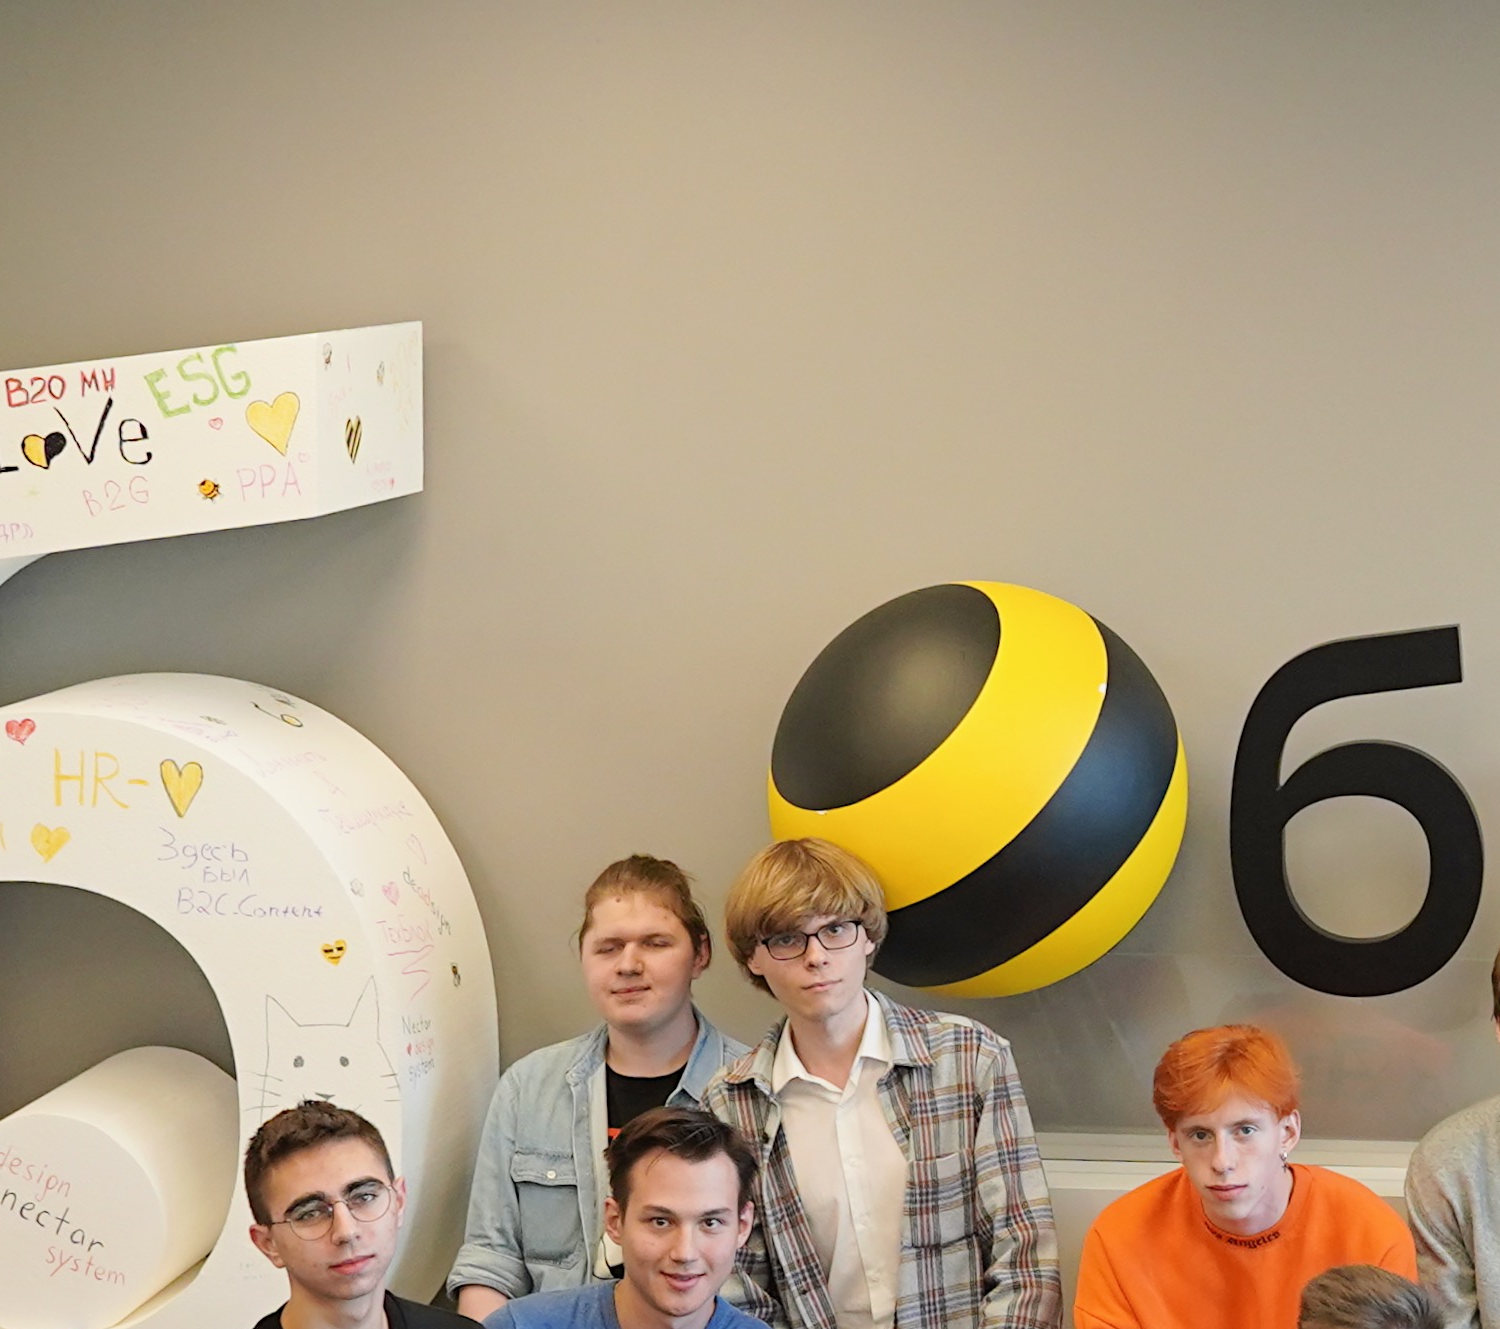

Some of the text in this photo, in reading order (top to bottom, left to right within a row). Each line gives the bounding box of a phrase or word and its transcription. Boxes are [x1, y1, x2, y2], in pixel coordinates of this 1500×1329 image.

[143, 343, 252, 419] ESG
[0, 1188, 105, 1252] nectar
[45, 1246, 126, 1286] system
